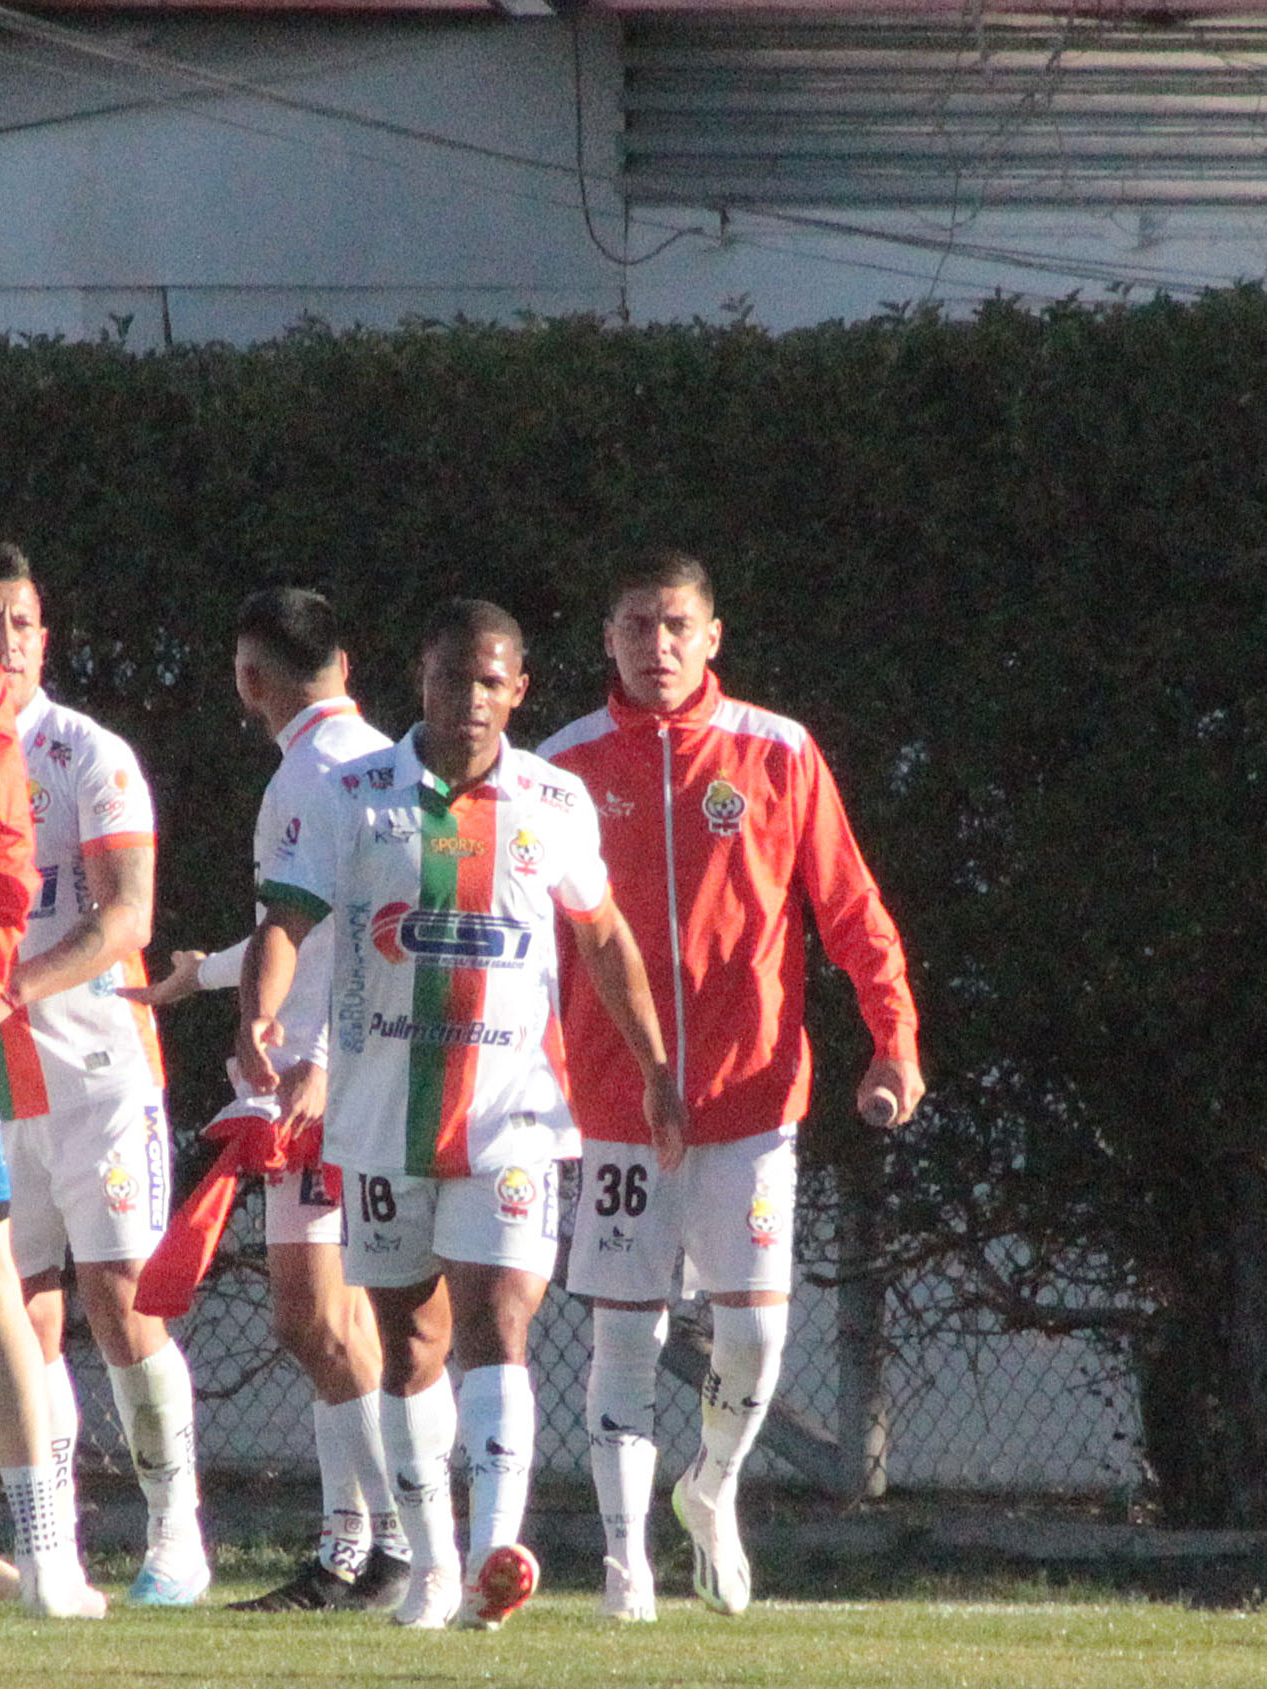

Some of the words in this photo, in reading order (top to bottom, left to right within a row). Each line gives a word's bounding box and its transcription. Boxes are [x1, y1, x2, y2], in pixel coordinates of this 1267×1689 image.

[538, 783, 576, 807] TEC
[432, 837, 485, 855] SPORTS
[369, 1012, 462, 1041] Pullman
[467, 1021, 513, 1046] Bus
[358, 1173, 397, 1223] 18
[595, 1163, 648, 1217] 36
[598, 1238, 634, 1252] KS7
